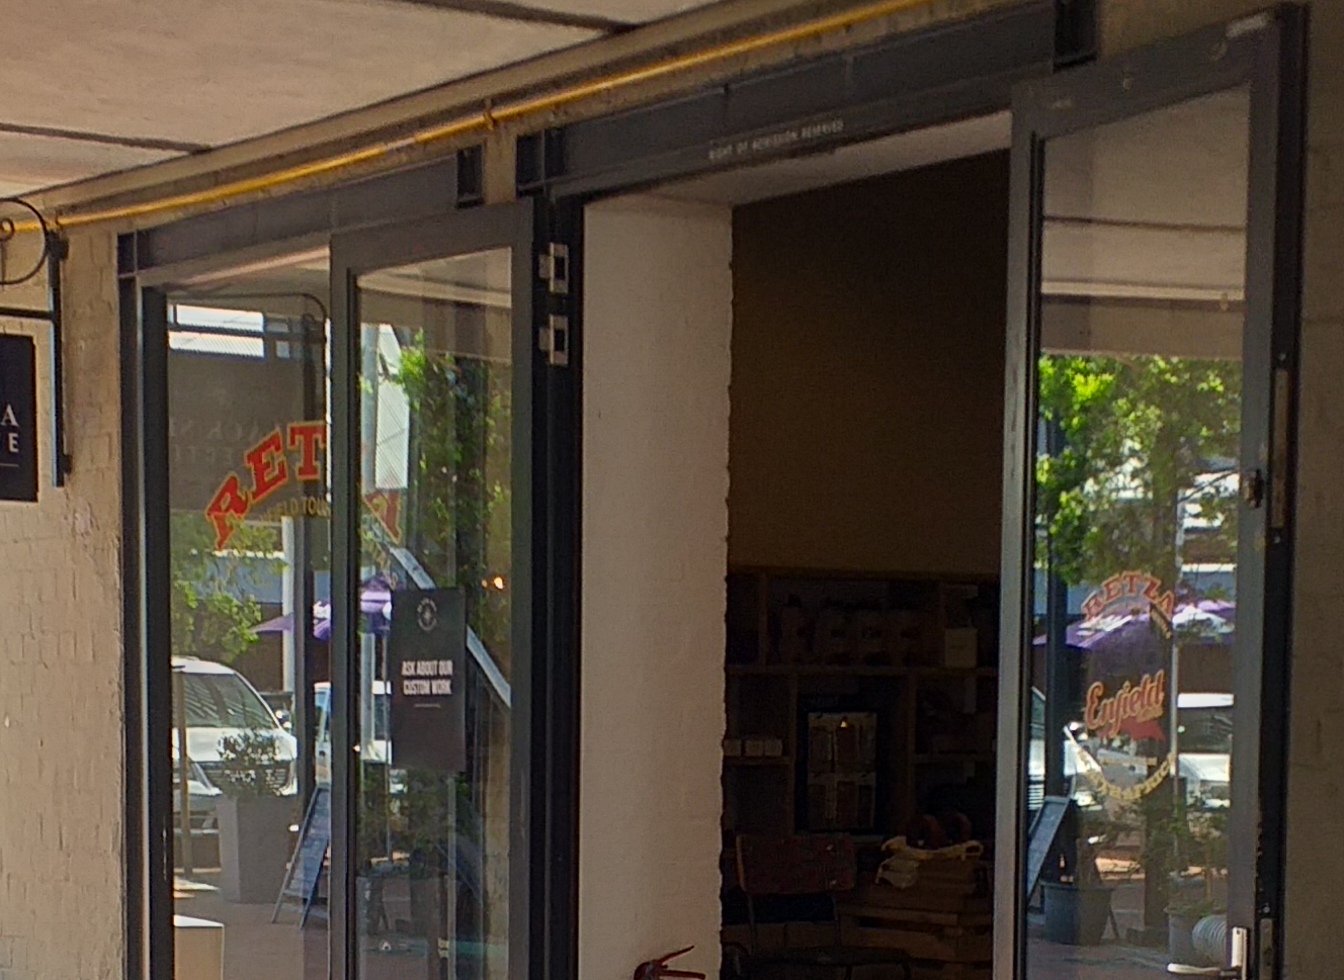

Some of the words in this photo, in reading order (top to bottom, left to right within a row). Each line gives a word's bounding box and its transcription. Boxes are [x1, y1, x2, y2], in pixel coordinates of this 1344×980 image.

[401, 660, 416, 676] ASK
[416, 660, 438, 676] ABOUT
[403, 679, 431, 695] CUSTOM
